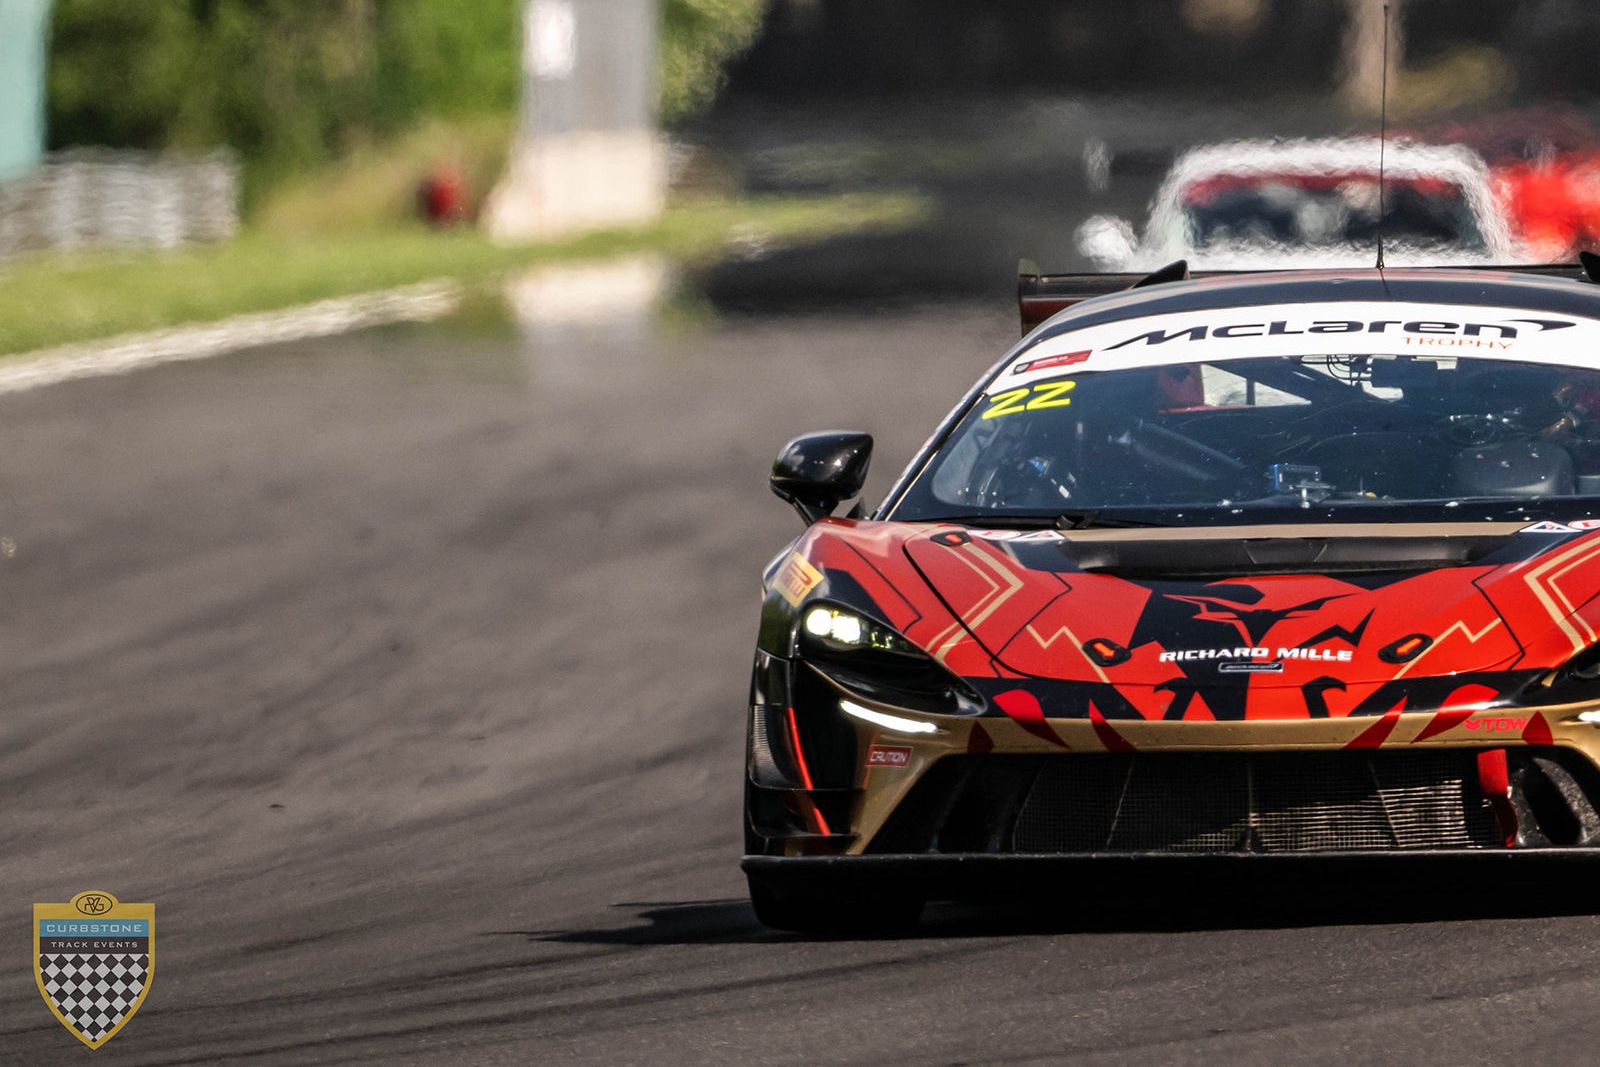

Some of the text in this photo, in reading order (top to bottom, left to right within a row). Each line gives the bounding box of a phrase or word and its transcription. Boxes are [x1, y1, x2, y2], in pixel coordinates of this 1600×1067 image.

[1402, 337, 1513, 349] TROPHY
[982, 380, 1076, 420] 22
[1159, 647, 1353, 662] RICHARD MILLE
[1484, 717, 1529, 732] TOW
